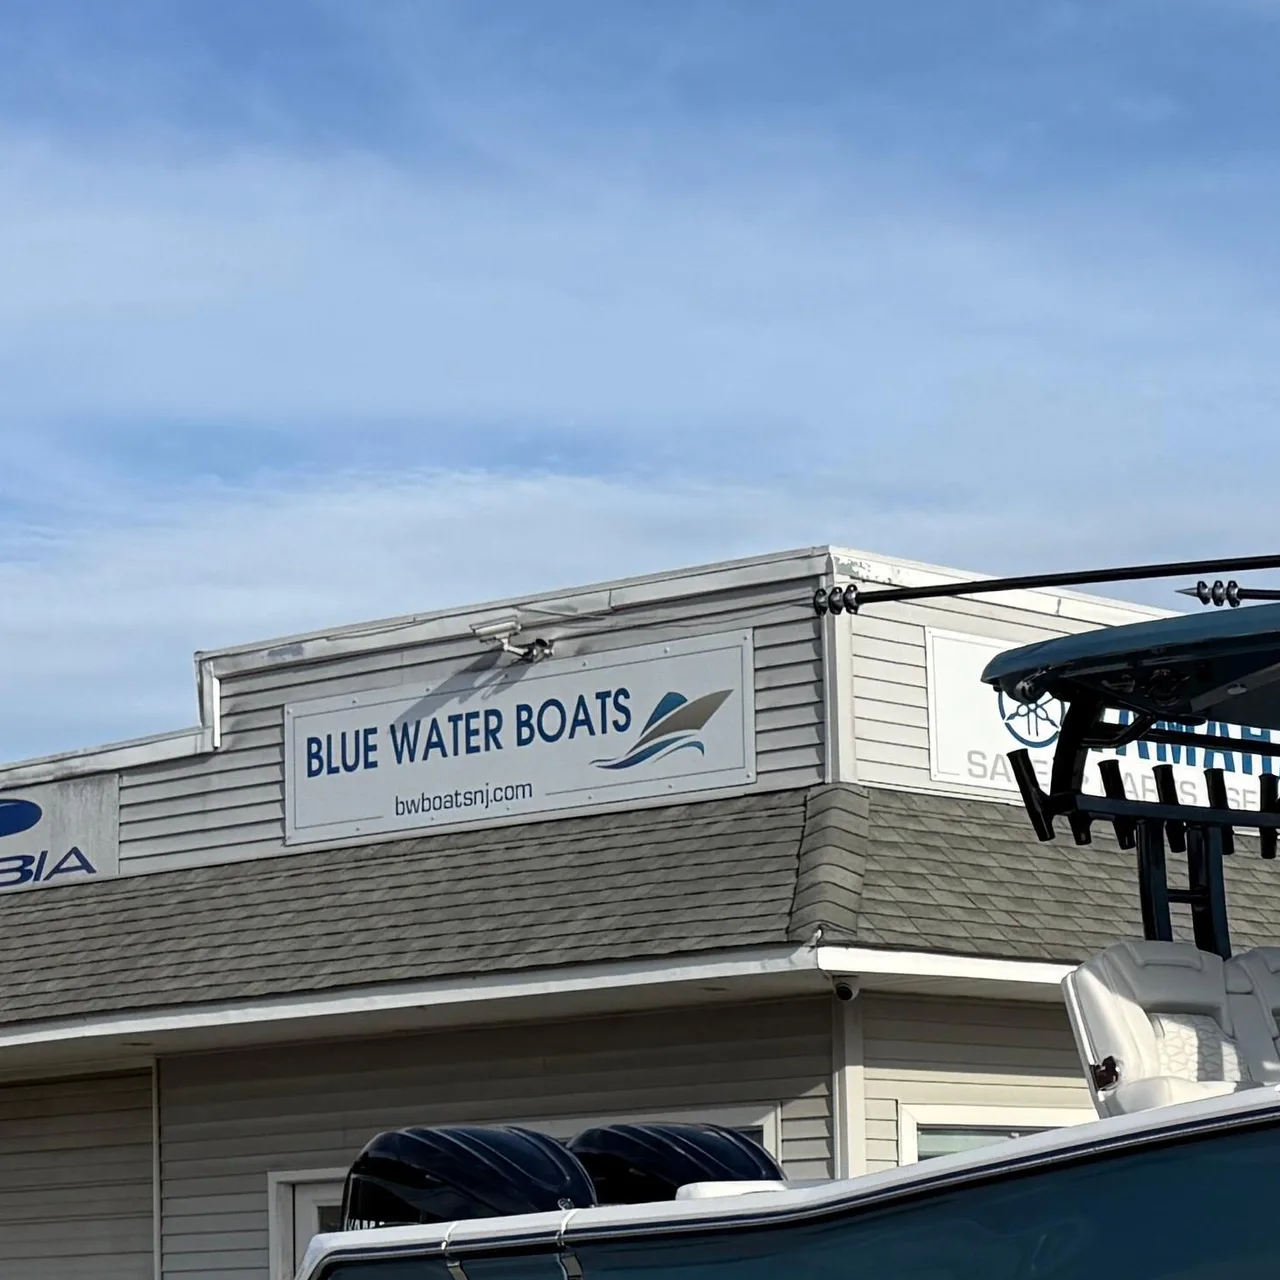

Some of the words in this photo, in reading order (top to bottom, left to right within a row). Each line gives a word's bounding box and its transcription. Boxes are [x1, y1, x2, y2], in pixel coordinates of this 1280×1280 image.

[306, 726, 379, 779] BLUE
[388, 708, 504, 766] WATER
[516, 687, 632, 748] BOATS
[395, 781, 533, 816] bwboatsnj.com
